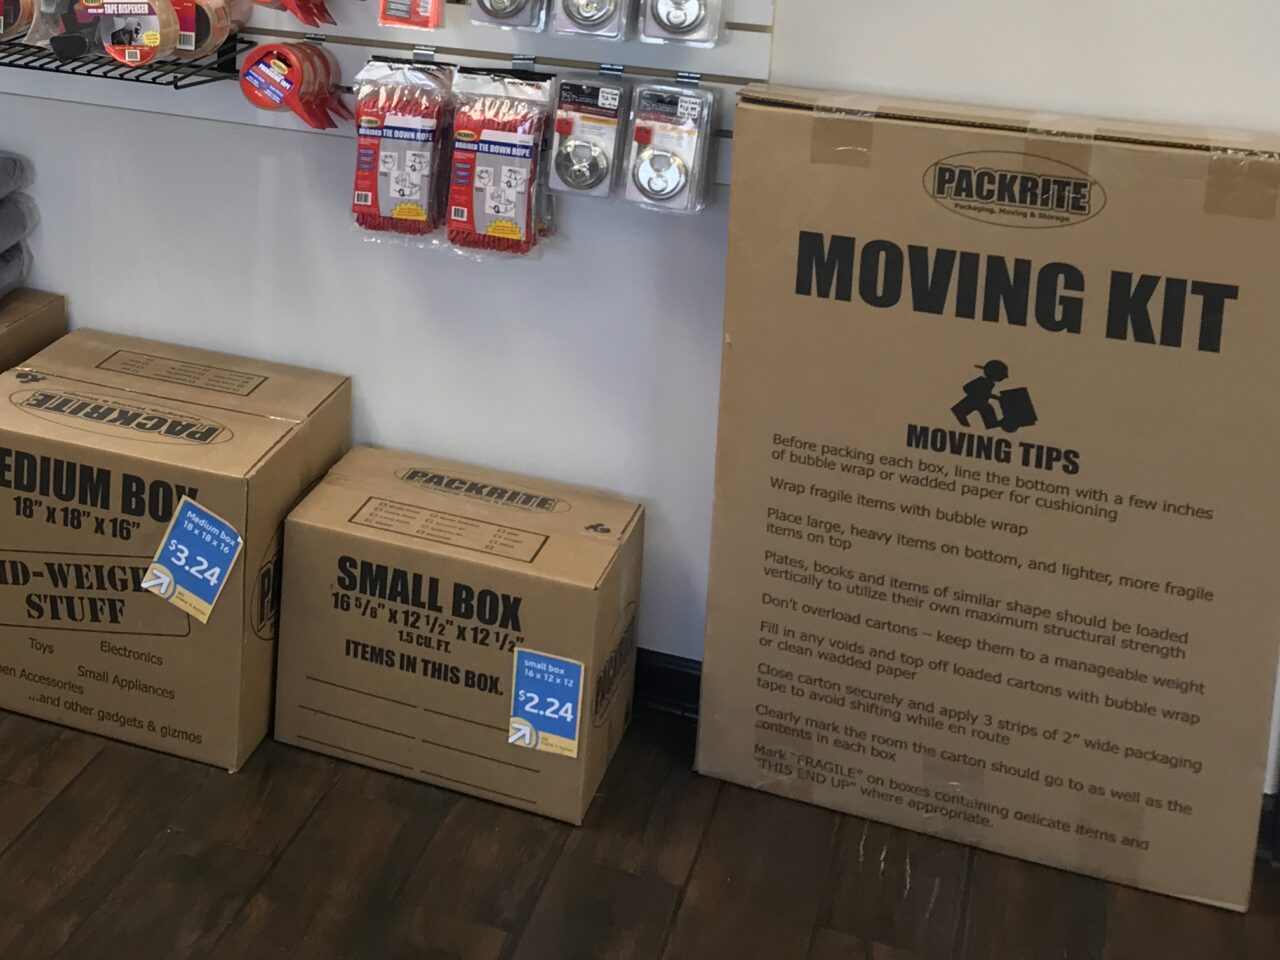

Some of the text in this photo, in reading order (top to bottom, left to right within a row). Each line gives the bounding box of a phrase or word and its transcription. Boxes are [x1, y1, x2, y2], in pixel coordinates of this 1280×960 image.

[105, 3, 149, 14] TAPE DISPENSER
[382, 129, 432, 140] TIE DOWN ROPE
[478, 142, 488, 152] TIE
[490, 144, 511, 154] DOWN
[512, 145, 529, 157] ROPE
[934, 165, 1092, 215] PACKRITE
[795, 230, 1239, 354] MOVING KIT
[24, 391, 226, 444] PACKRITE
[907, 424, 1080, 475] MOVING TIPS
[406, 467, 558, 511] PACKRITE
[773, 434, 1213, 520] Before packing each box, line the bottom with a few inches
[187, 511, 236, 546] Medium box
[770, 476, 1028, 537] Wrap fragile items with bubble wrap
[169, 540, 221, 586] $3.24
[26, 593, 126, 624] STUFF
[337, 555, 522, 632] SMALL BOX
[29, 637, 54, 654] Toys
[100, 641, 163, 665] Electronics
[345, 639, 396, 672] ITEMS
[399, 653, 417, 675] IN
[422, 659, 460, 685] THIS
[524, 659, 565, 676] small box
[518, 690, 574, 722] $2.24
